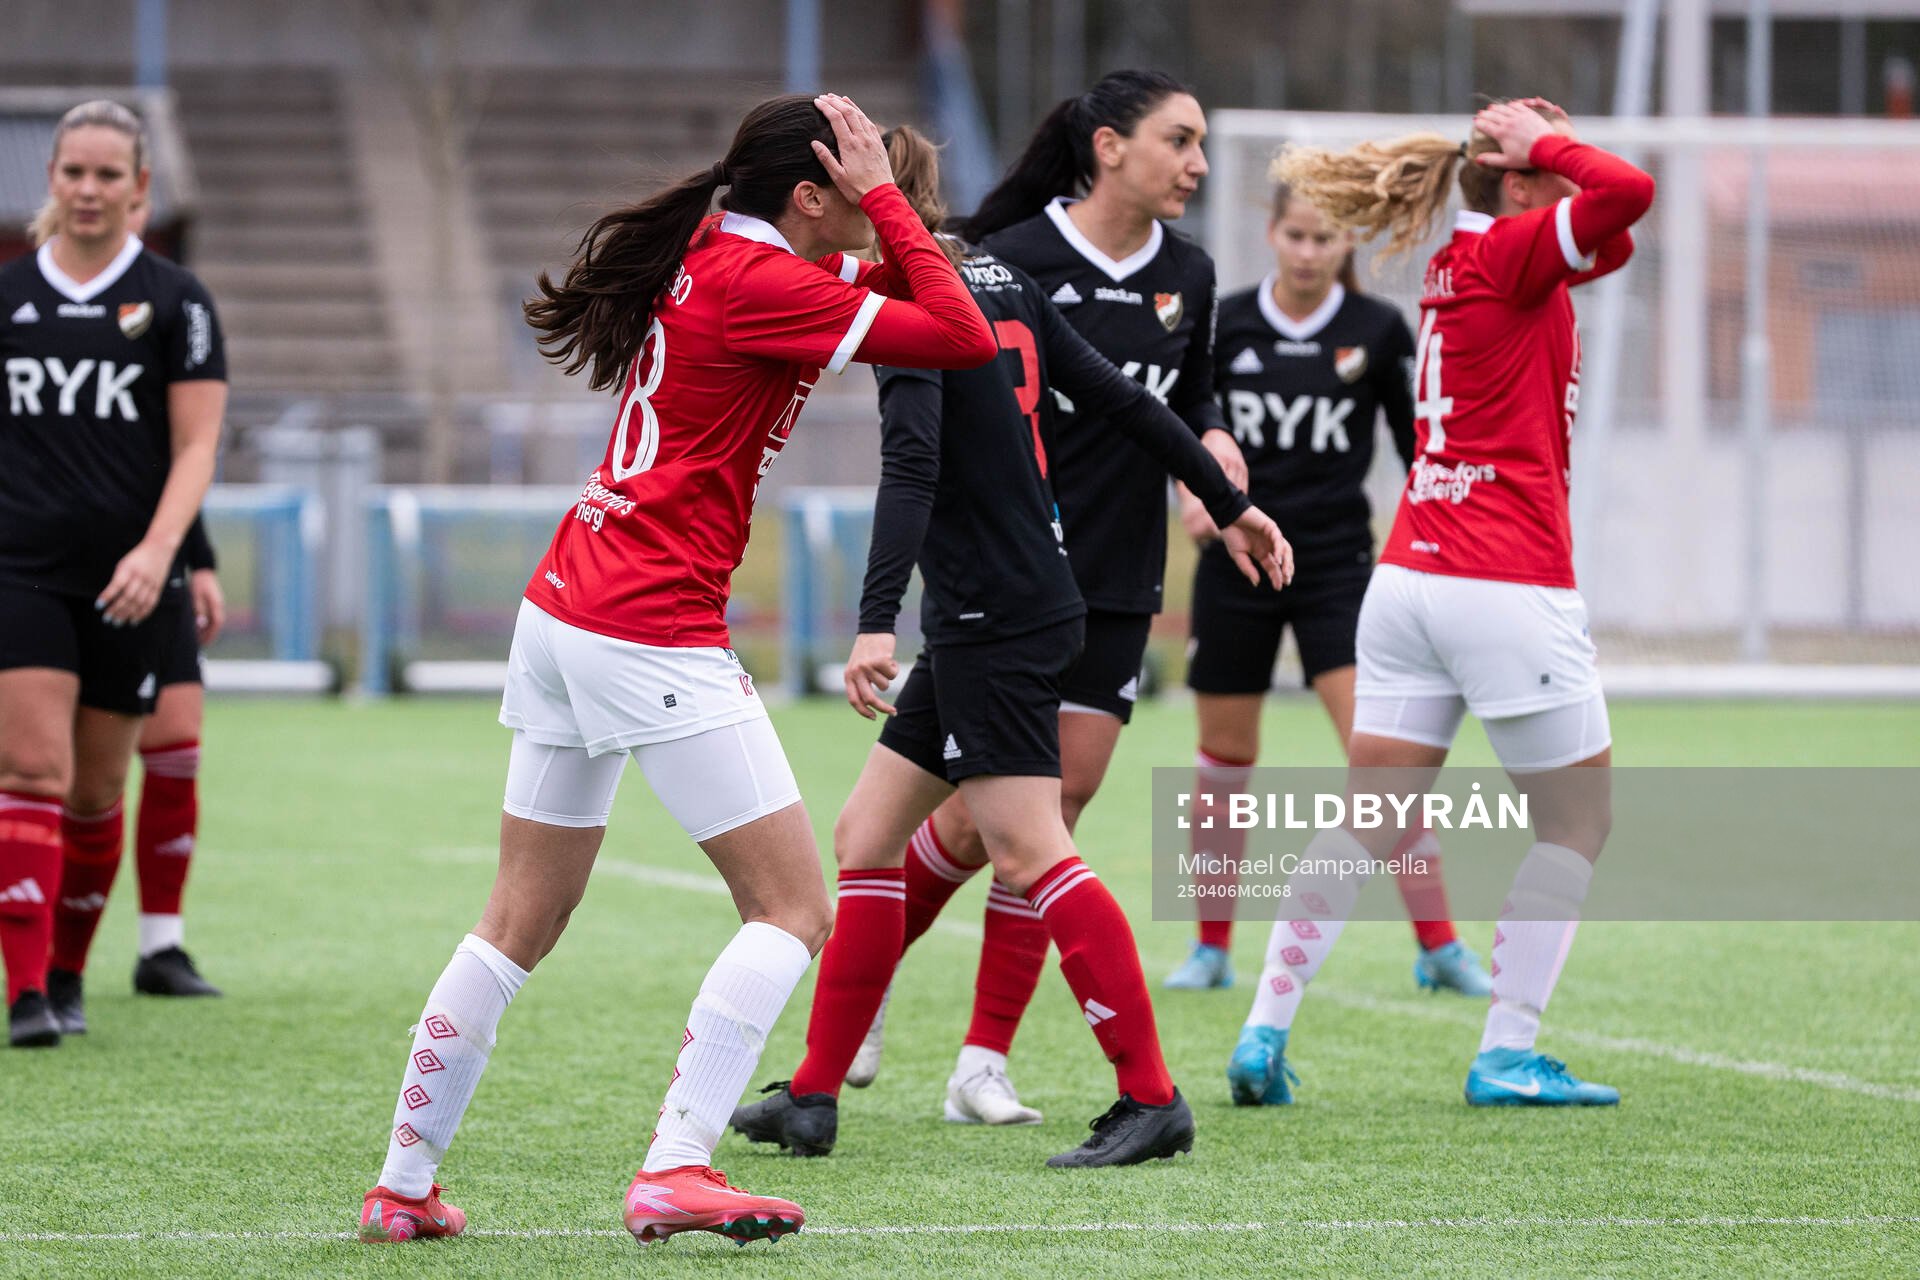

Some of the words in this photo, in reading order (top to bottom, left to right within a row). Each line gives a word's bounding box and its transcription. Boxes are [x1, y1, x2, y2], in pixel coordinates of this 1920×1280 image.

[5, 357, 144, 422] RYK
[1228, 389, 1357, 453] RYK
[738, 675, 753, 696] 18
